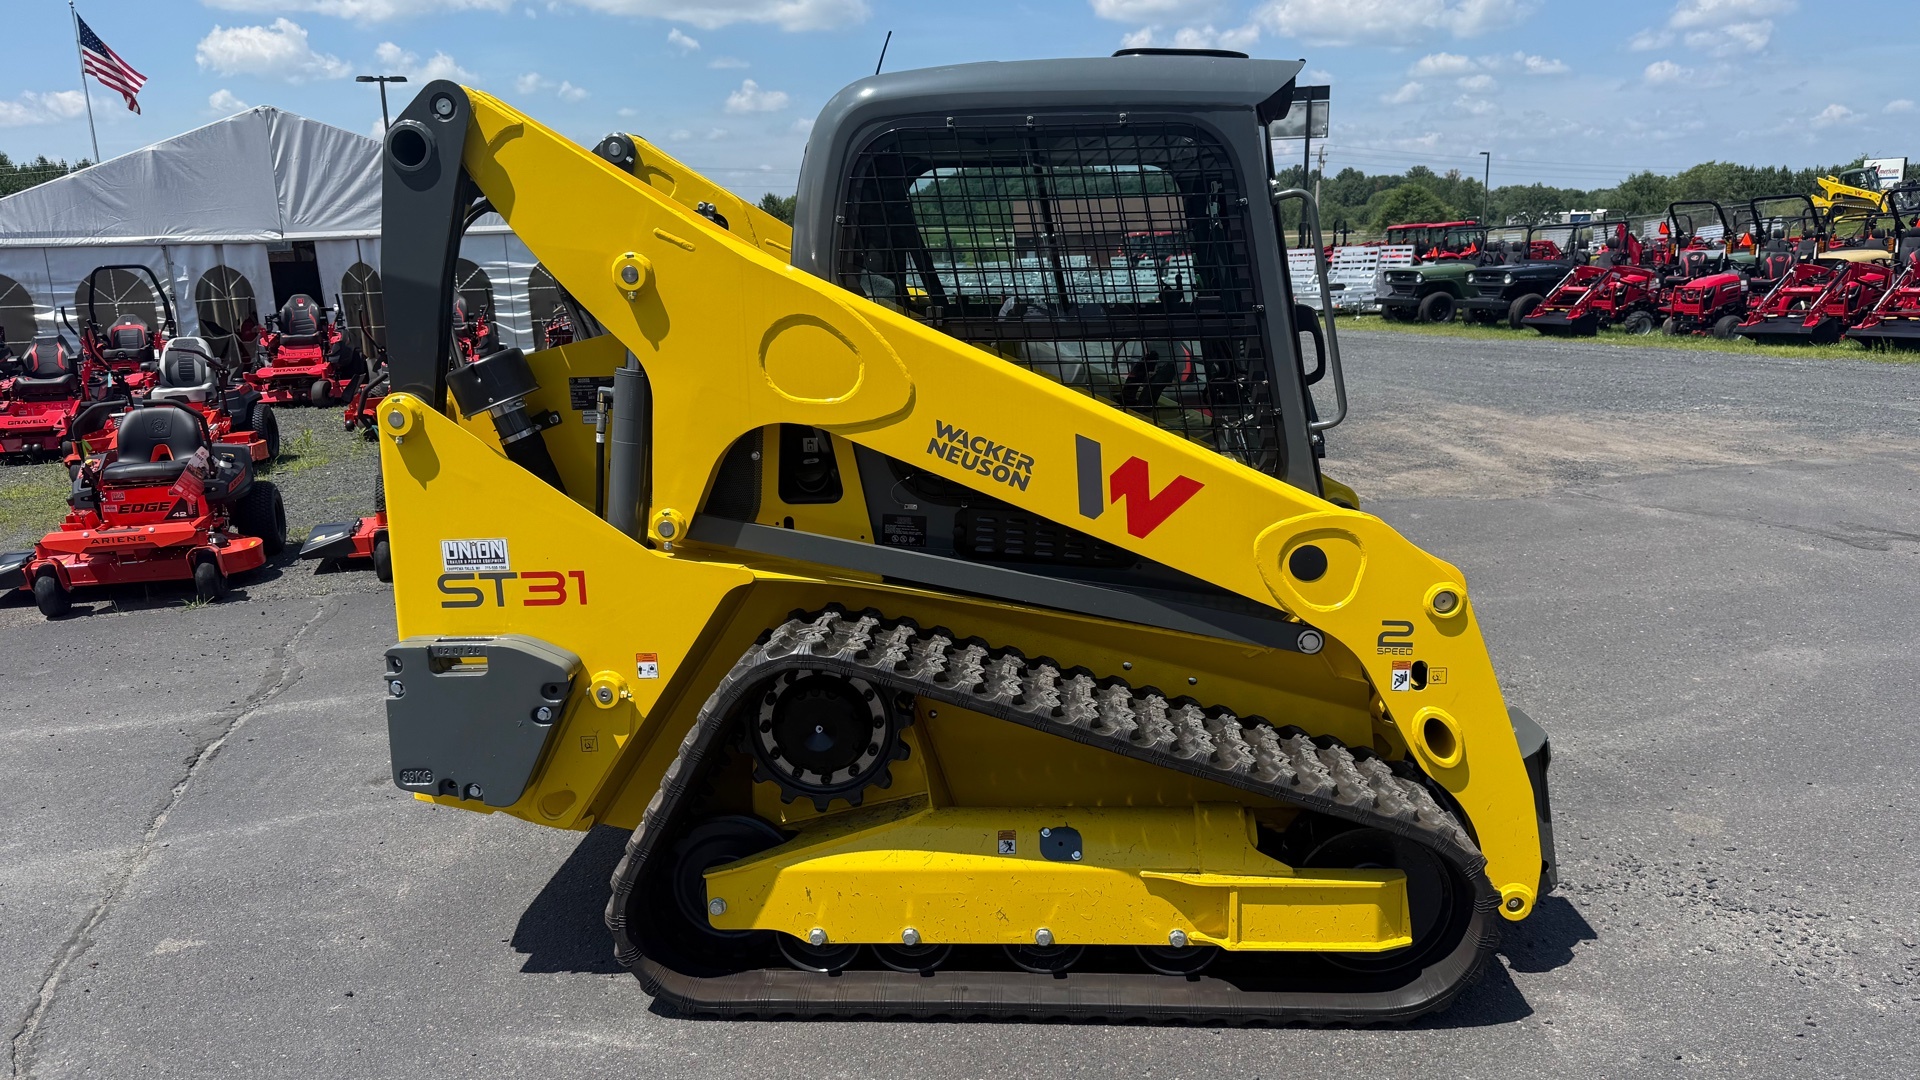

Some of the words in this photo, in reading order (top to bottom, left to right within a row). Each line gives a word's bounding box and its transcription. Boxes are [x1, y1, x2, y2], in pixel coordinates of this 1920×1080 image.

[7, 418, 48, 426] GRAVELY
[935, 419, 1035, 475] WACKER
[926, 437, 1030, 492] NEUSON
[118, 501, 172, 514] EDGE
[90, 535, 147, 545] ARIENS
[437, 570, 588, 609] ST31
[1377, 620, 1415, 648] 2
[1376, 648, 1413, 656] SPEED
